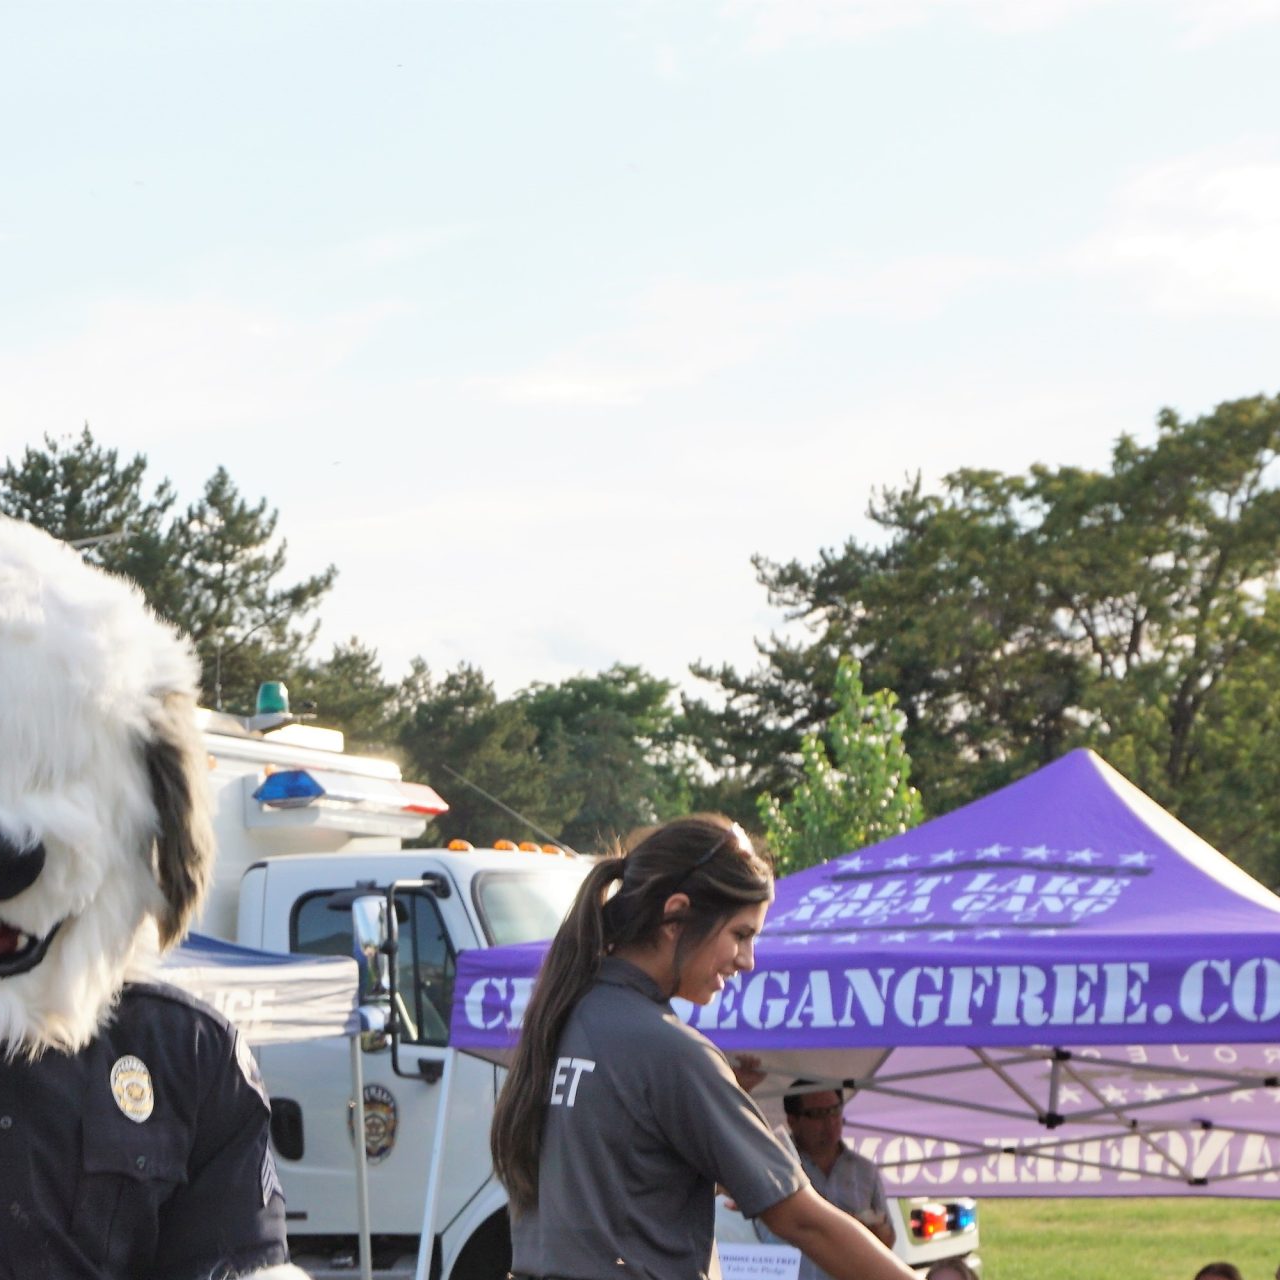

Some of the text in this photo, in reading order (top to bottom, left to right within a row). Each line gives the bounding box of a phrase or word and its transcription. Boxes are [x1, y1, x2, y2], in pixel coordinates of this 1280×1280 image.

[799, 872, 1131, 905] SALT LAKE
[774, 894, 1118, 922] AREA GANG
[551, 1057, 596, 1108] ET
